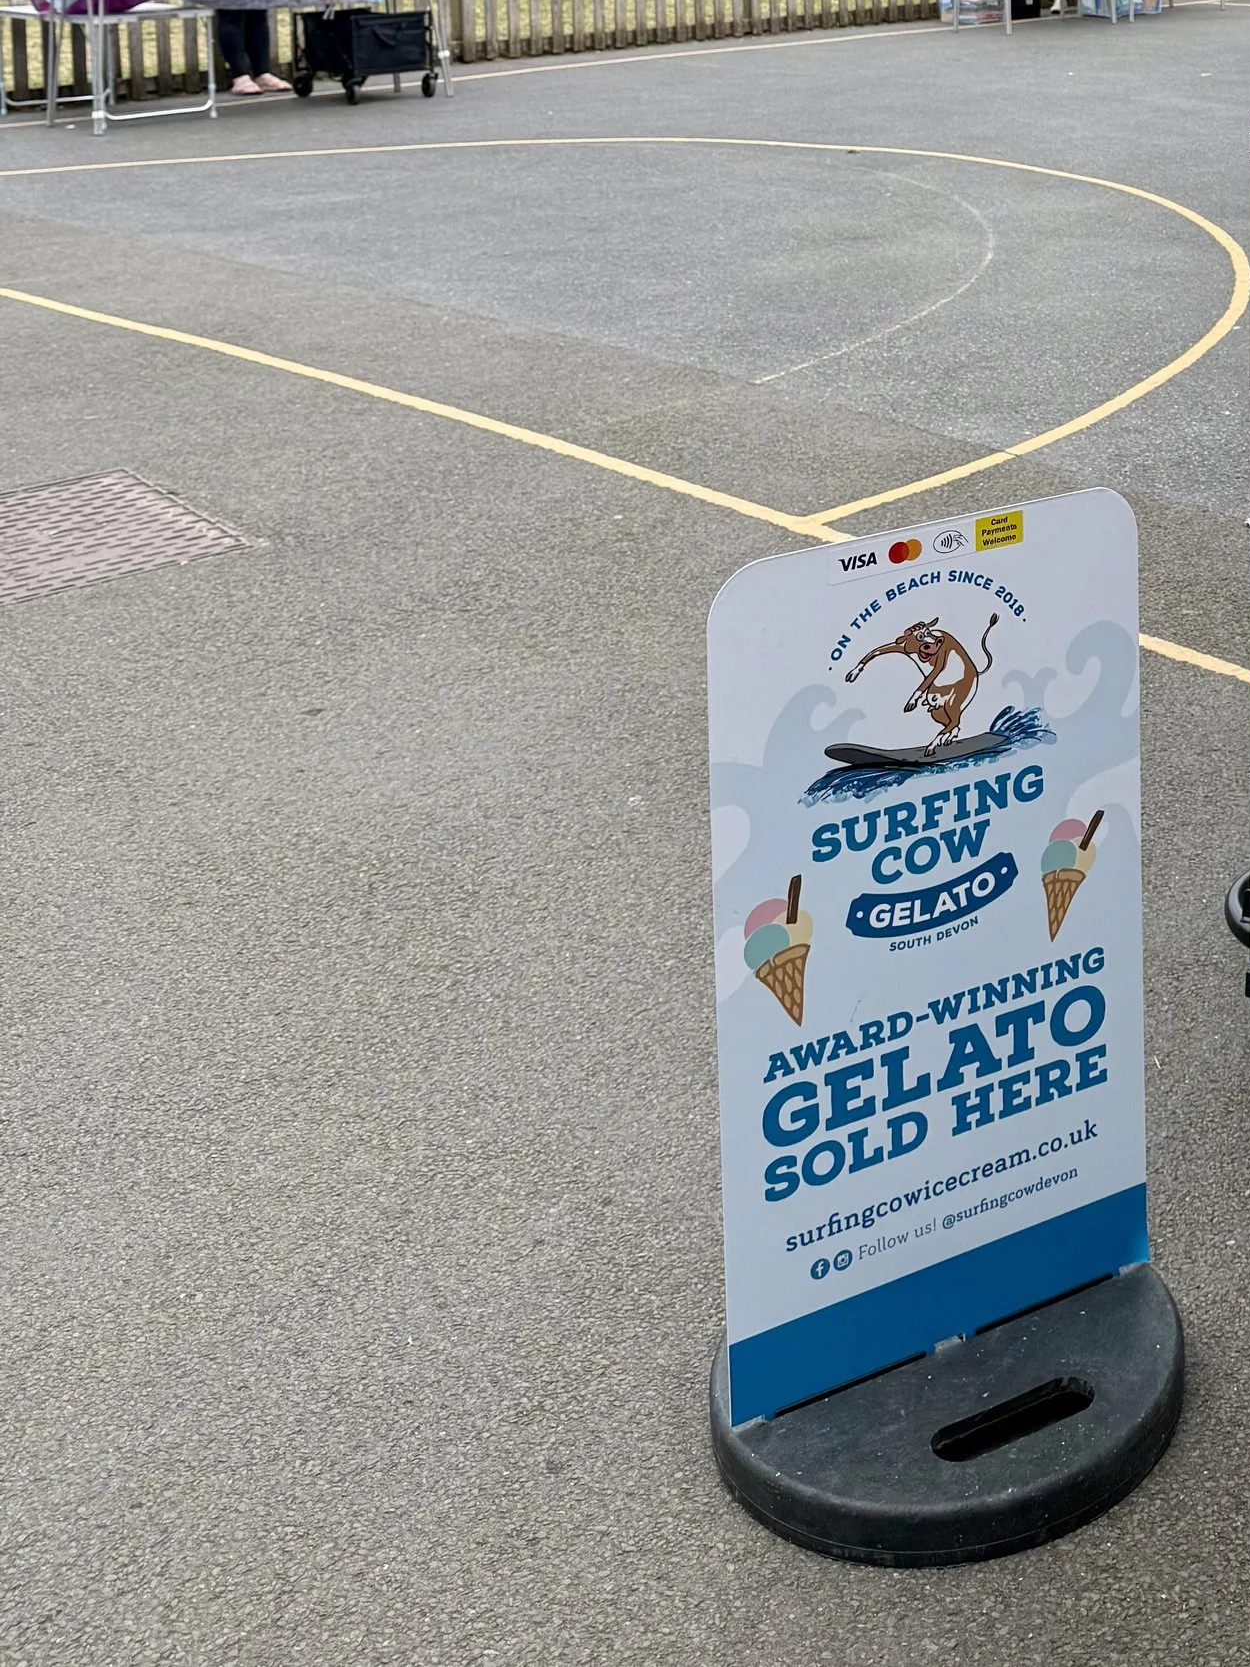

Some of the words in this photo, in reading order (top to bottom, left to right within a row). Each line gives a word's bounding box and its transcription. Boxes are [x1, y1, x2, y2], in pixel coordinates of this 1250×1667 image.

[981, 523, 1017, 537] Payments
[982, 534, 1017, 547] Welcome
[990, 516, 1008, 526] Card
[838, 551, 878, 572] VISA
[830, 634, 852, 662] ON
[850, 599, 882, 630] THE
[885, 570, 942, 602] BEACH
[947, 570, 994, 591] SINCE
[994, 585, 1026, 617] 2018
[811, 764, 1045, 864] SURFING
[871, 818, 992, 885] COW
[868, 876, 996, 929] GELATO
[889, 934, 933, 952] SOUTH
[936, 916, 980, 942] DEVON
[763, 946, 1106, 1084] AWARD-WINNING
[761, 984, 1107, 1148] GELATO
[764, 1110, 929, 1203] SOLD
[951, 1044, 1109, 1136] HERE
[785, 1119, 1099, 1253] surfingcowicecream.co.uk
[858, 1228, 910, 1261] Follow
[914, 1218, 938, 1241] us!
[941, 1166, 1080, 1231] @surfingcowdevon
